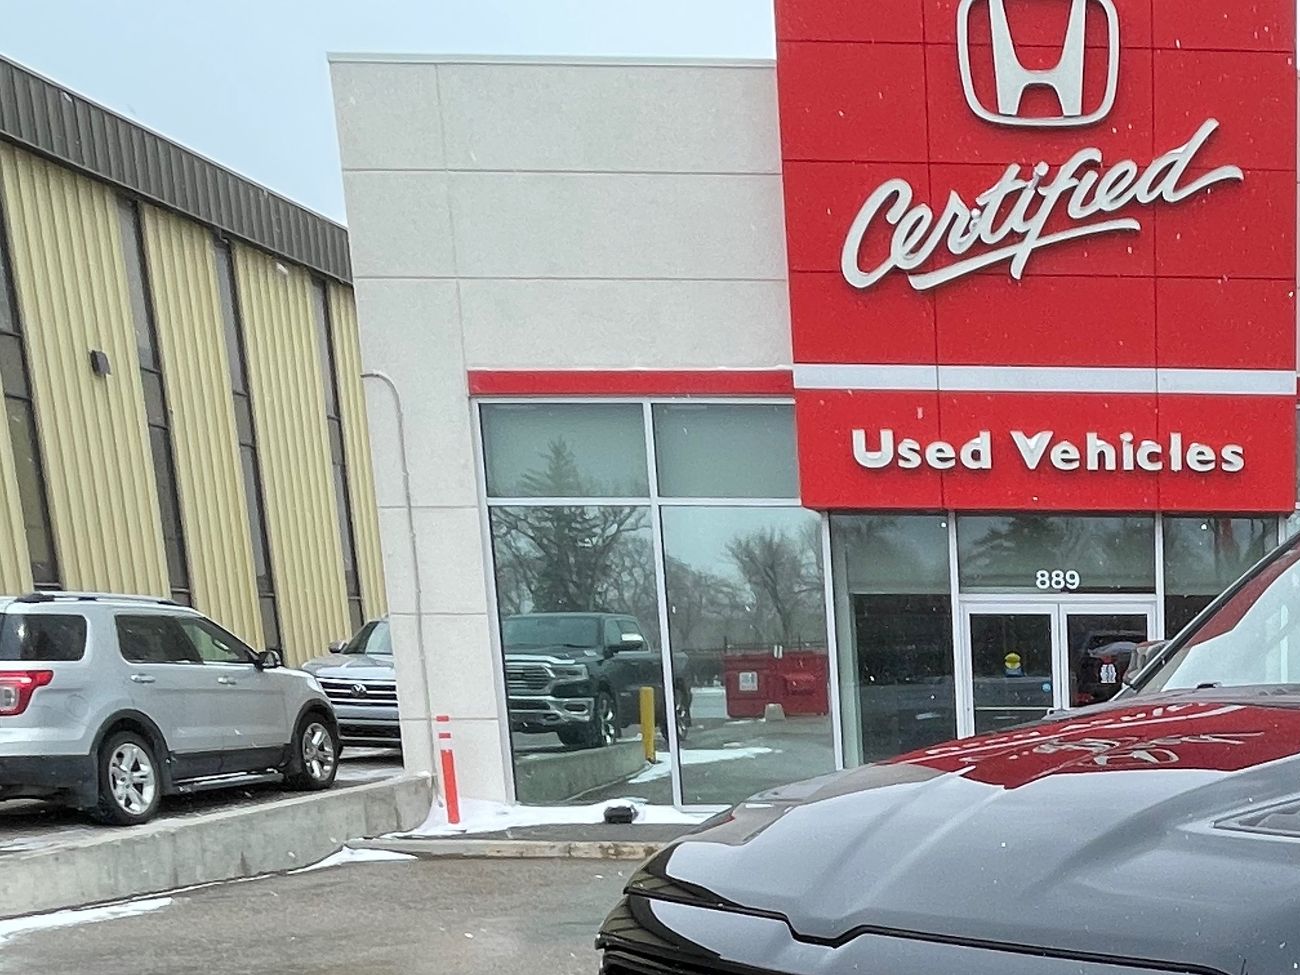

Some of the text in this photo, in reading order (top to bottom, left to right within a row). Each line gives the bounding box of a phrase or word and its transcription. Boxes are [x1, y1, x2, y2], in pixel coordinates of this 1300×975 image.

[841, 118, 1244, 290] Certified
[851, 428, 1245, 473] Used Vehicles
[1035, 569, 1081, 590] 889
